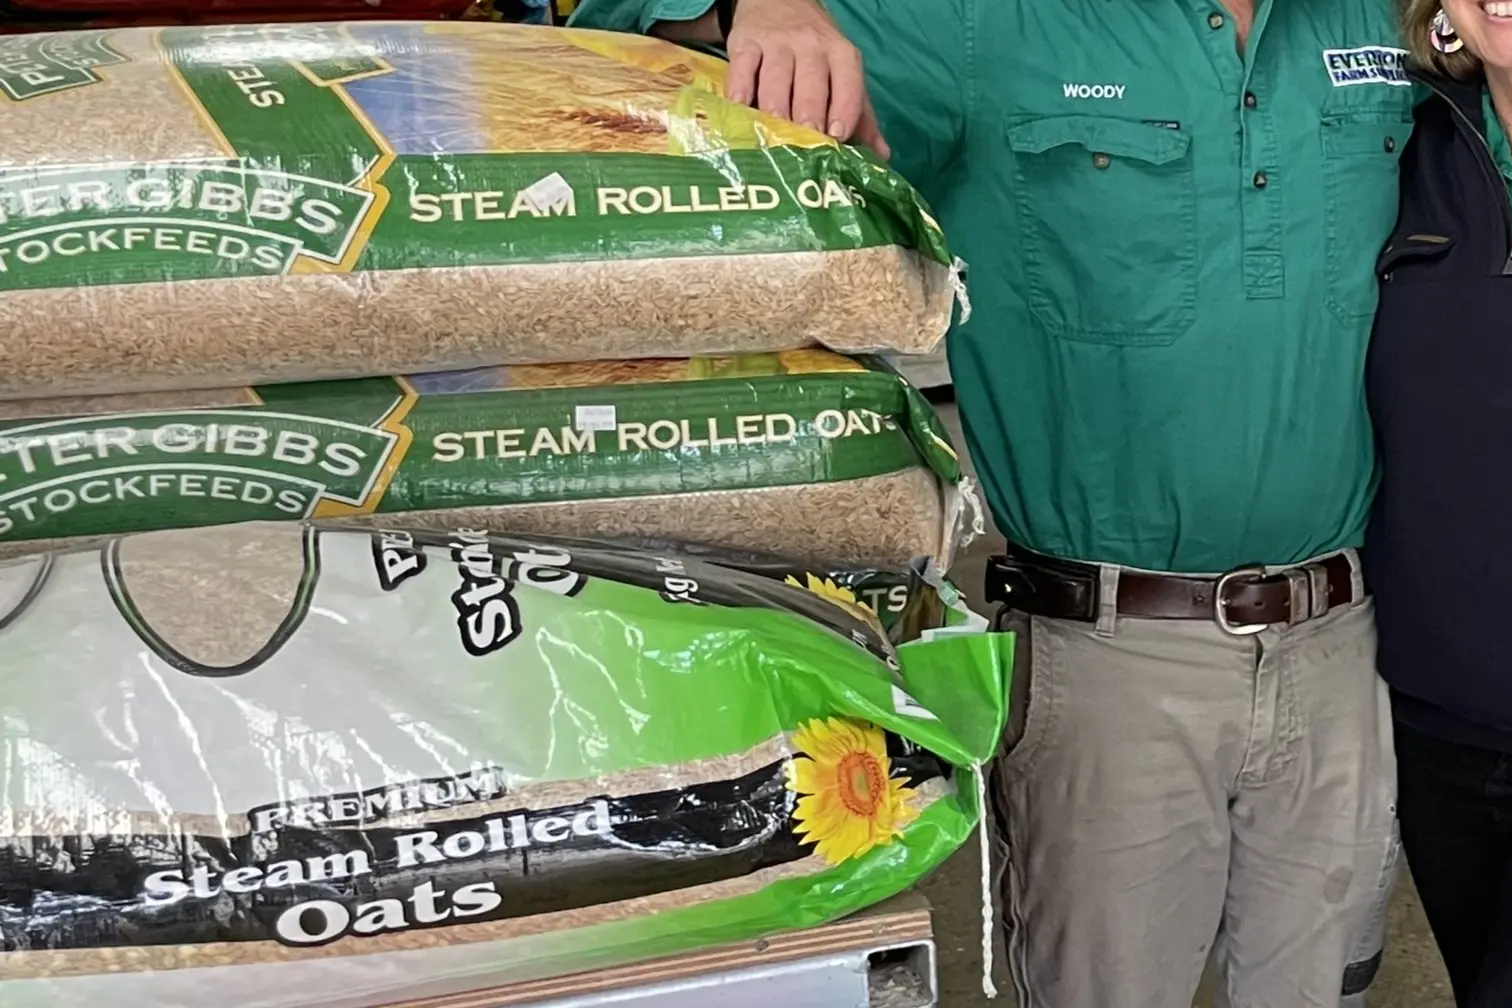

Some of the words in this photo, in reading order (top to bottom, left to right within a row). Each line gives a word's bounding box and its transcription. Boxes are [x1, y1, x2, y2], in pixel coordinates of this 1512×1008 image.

[1063, 83, 1126, 100] WOODY
[127, 178, 343, 236] GIBBS
[408, 188, 577, 223] STEAM
[597, 183, 780, 217] ROLLED
[0, 425, 138, 484] TER
[152, 422, 368, 478] GIBBS
[432, 427, 596, 463] STEAM
[617, 412, 799, 452] ROLLED
[252, 769, 500, 835] PREMIUM
[143, 848, 374, 906] Steam
[395, 802, 612, 870] Rolled
[275, 878, 502, 945] Oats
